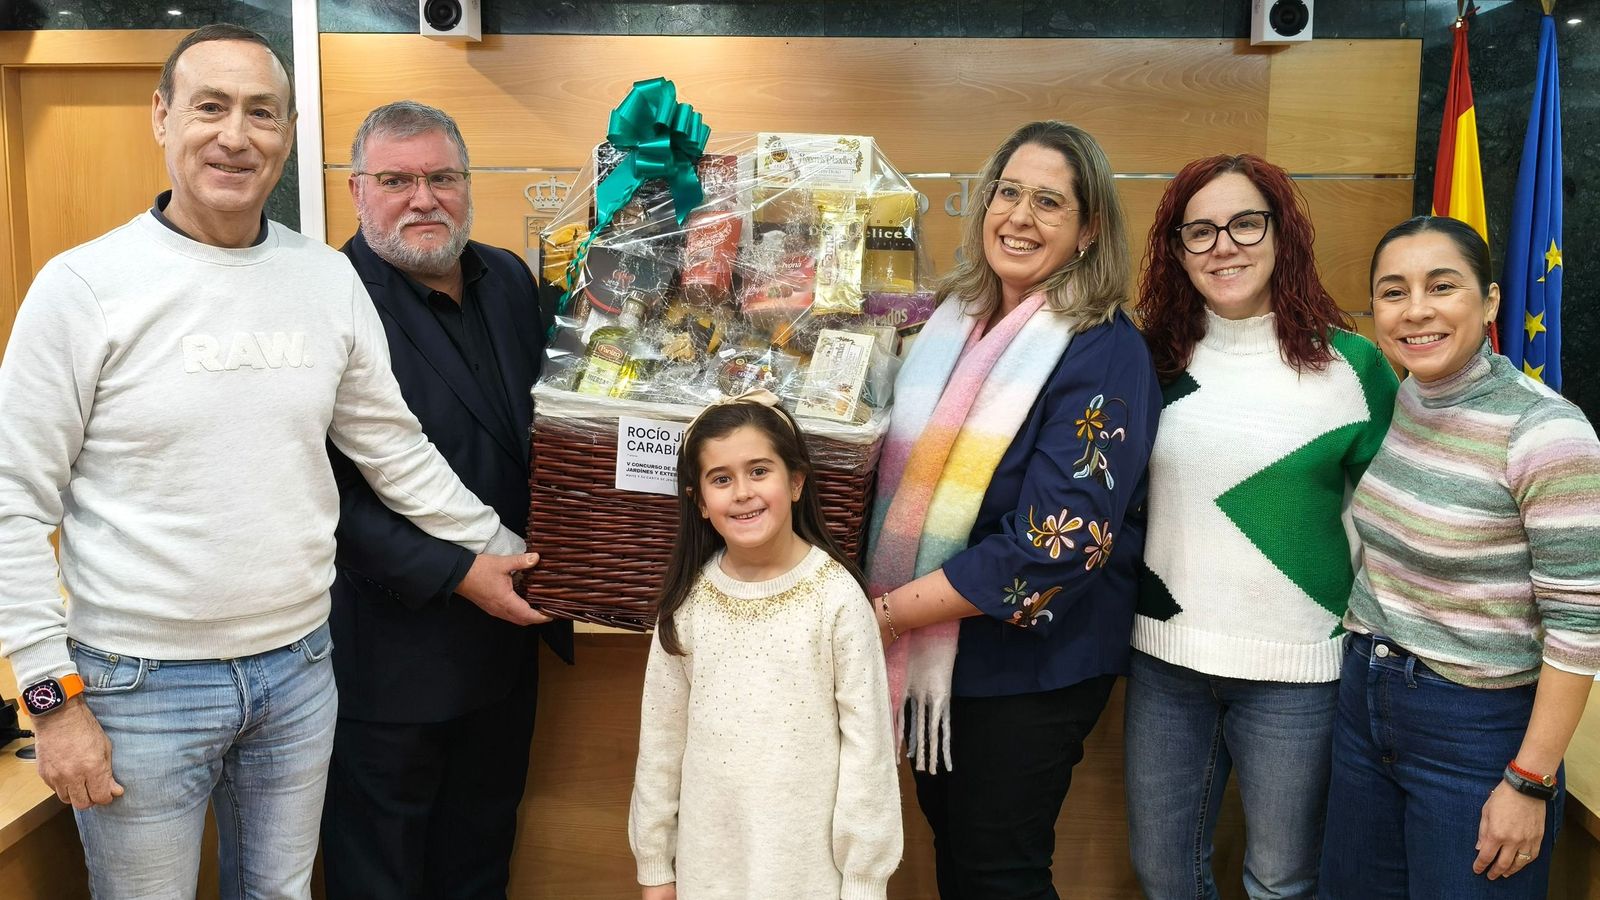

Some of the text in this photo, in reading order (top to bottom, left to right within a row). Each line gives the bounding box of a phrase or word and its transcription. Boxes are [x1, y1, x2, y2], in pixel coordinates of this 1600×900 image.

[181, 331, 314, 374] RAW.
[627, 426, 670, 441] ROCÍO
[631, 462, 662, 470] CONCURSO
